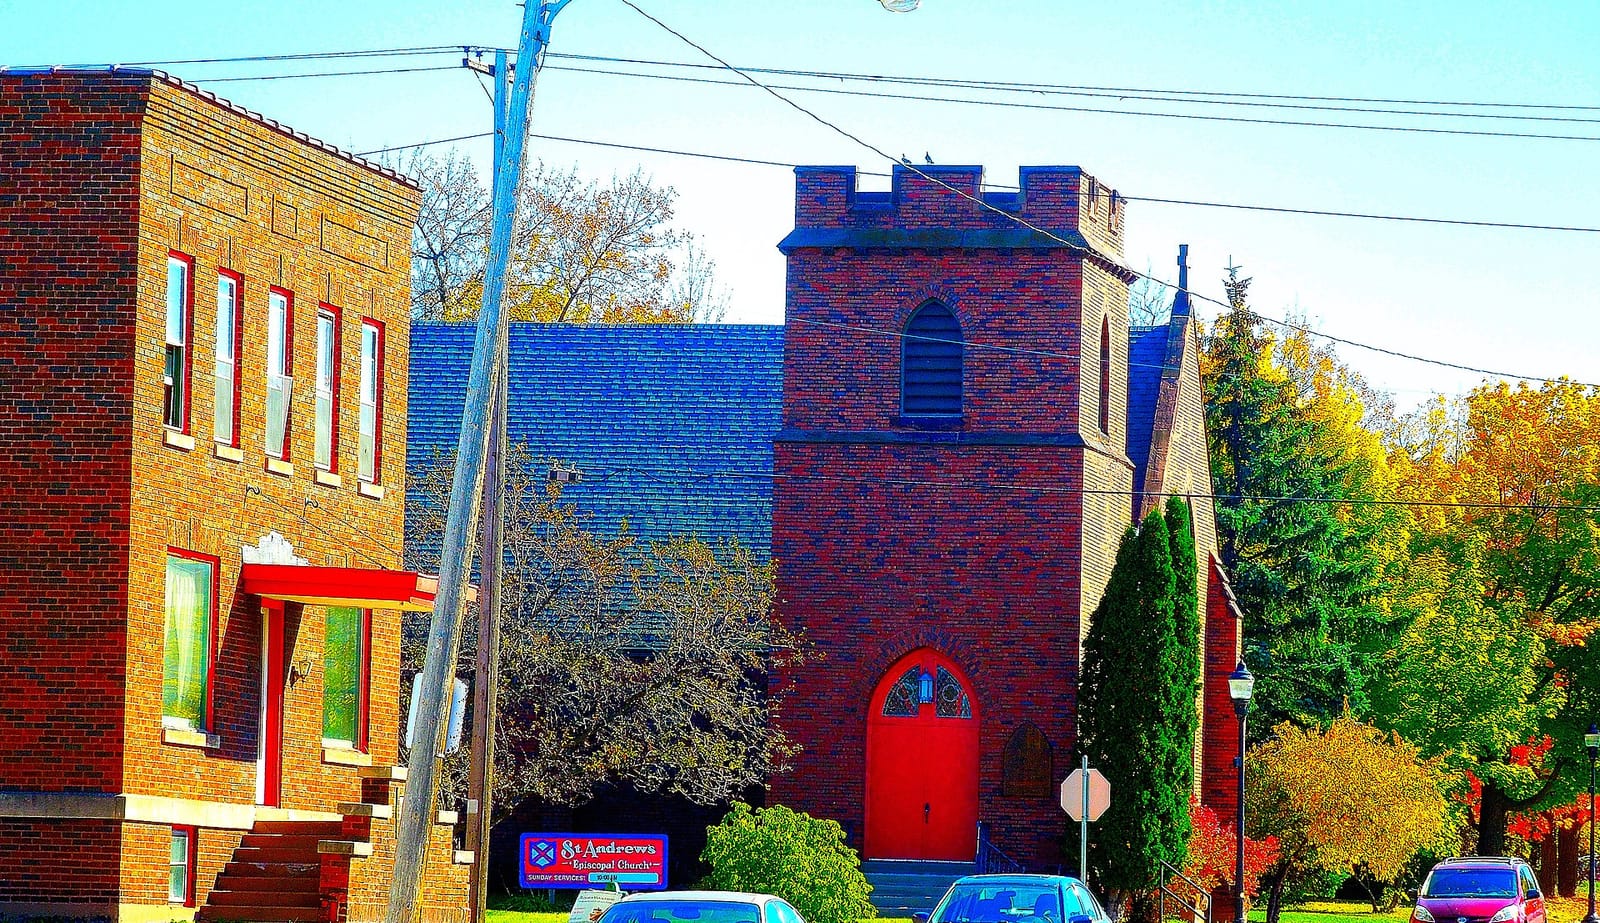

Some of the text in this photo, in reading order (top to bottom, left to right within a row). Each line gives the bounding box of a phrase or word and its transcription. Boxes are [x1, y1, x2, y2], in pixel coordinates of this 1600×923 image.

[573, 859, 649, 871] Episcopal Church
[527, 873, 552, 881] SUNDAY
